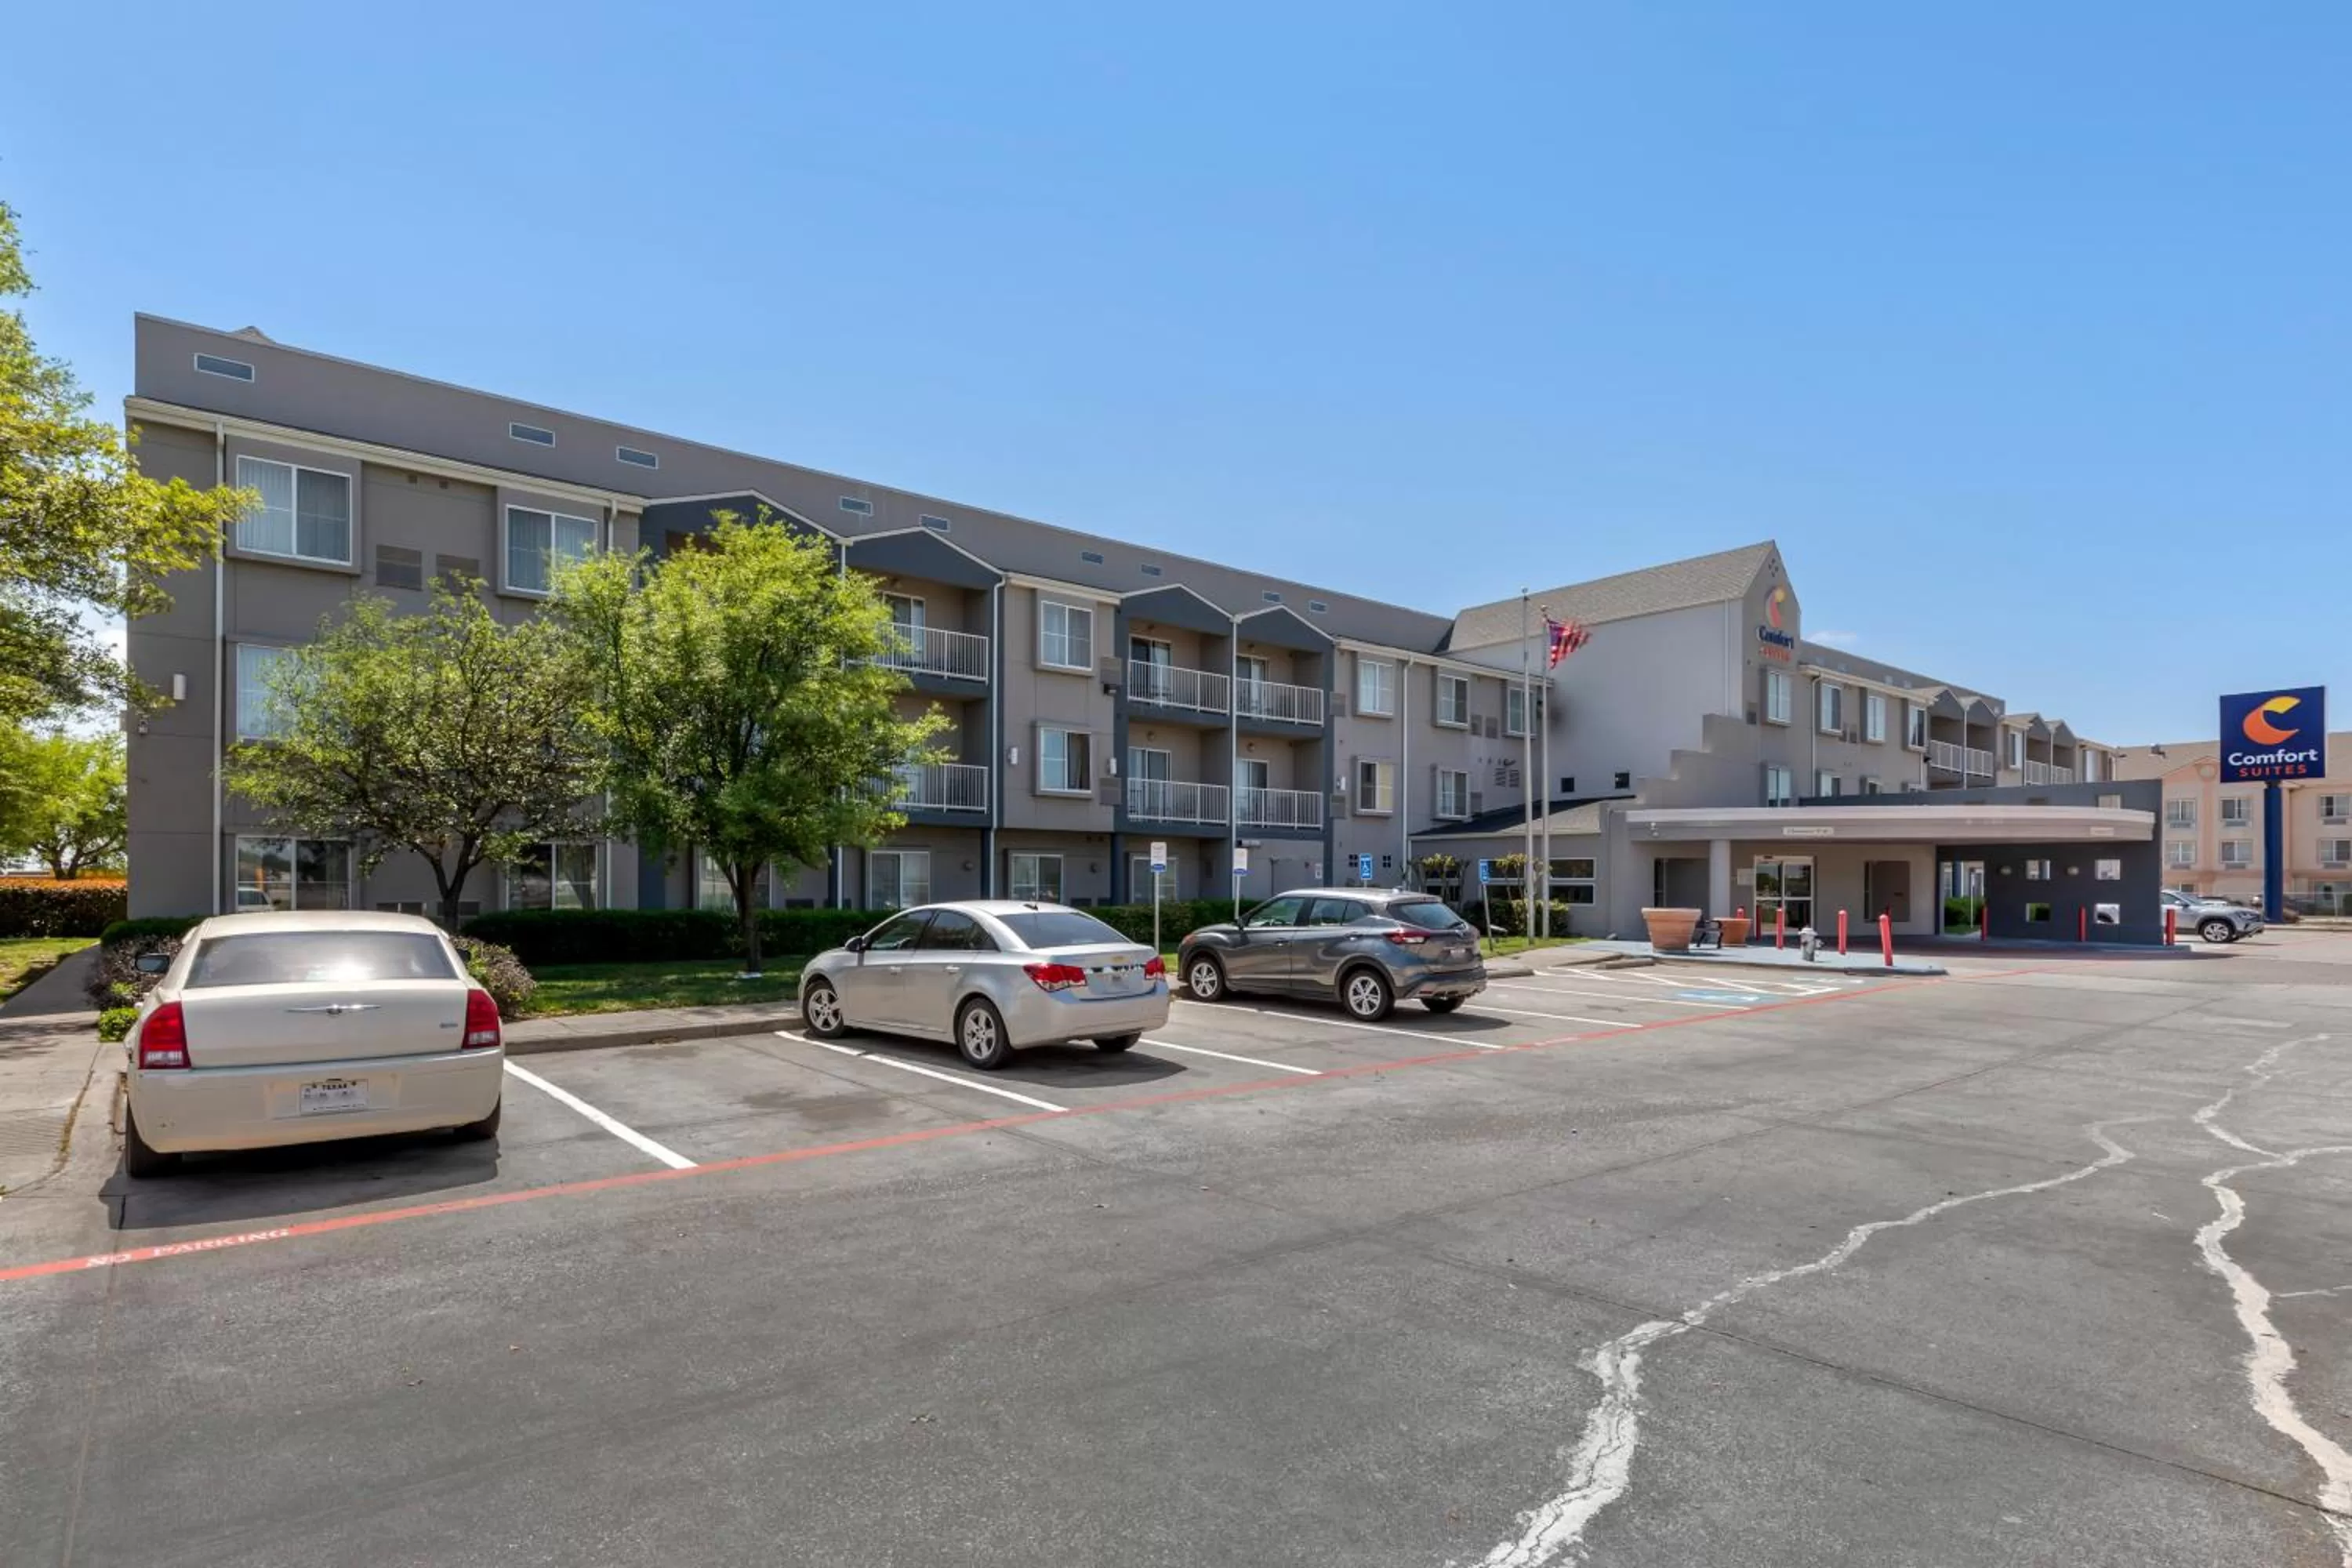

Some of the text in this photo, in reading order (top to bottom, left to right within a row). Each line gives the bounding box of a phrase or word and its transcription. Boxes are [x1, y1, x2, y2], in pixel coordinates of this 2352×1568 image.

[2228, 749, 2318, 766] Comfort
[2238, 764, 2307, 778] SUITES
[86, 1229, 289, 1268] NO PARKING
